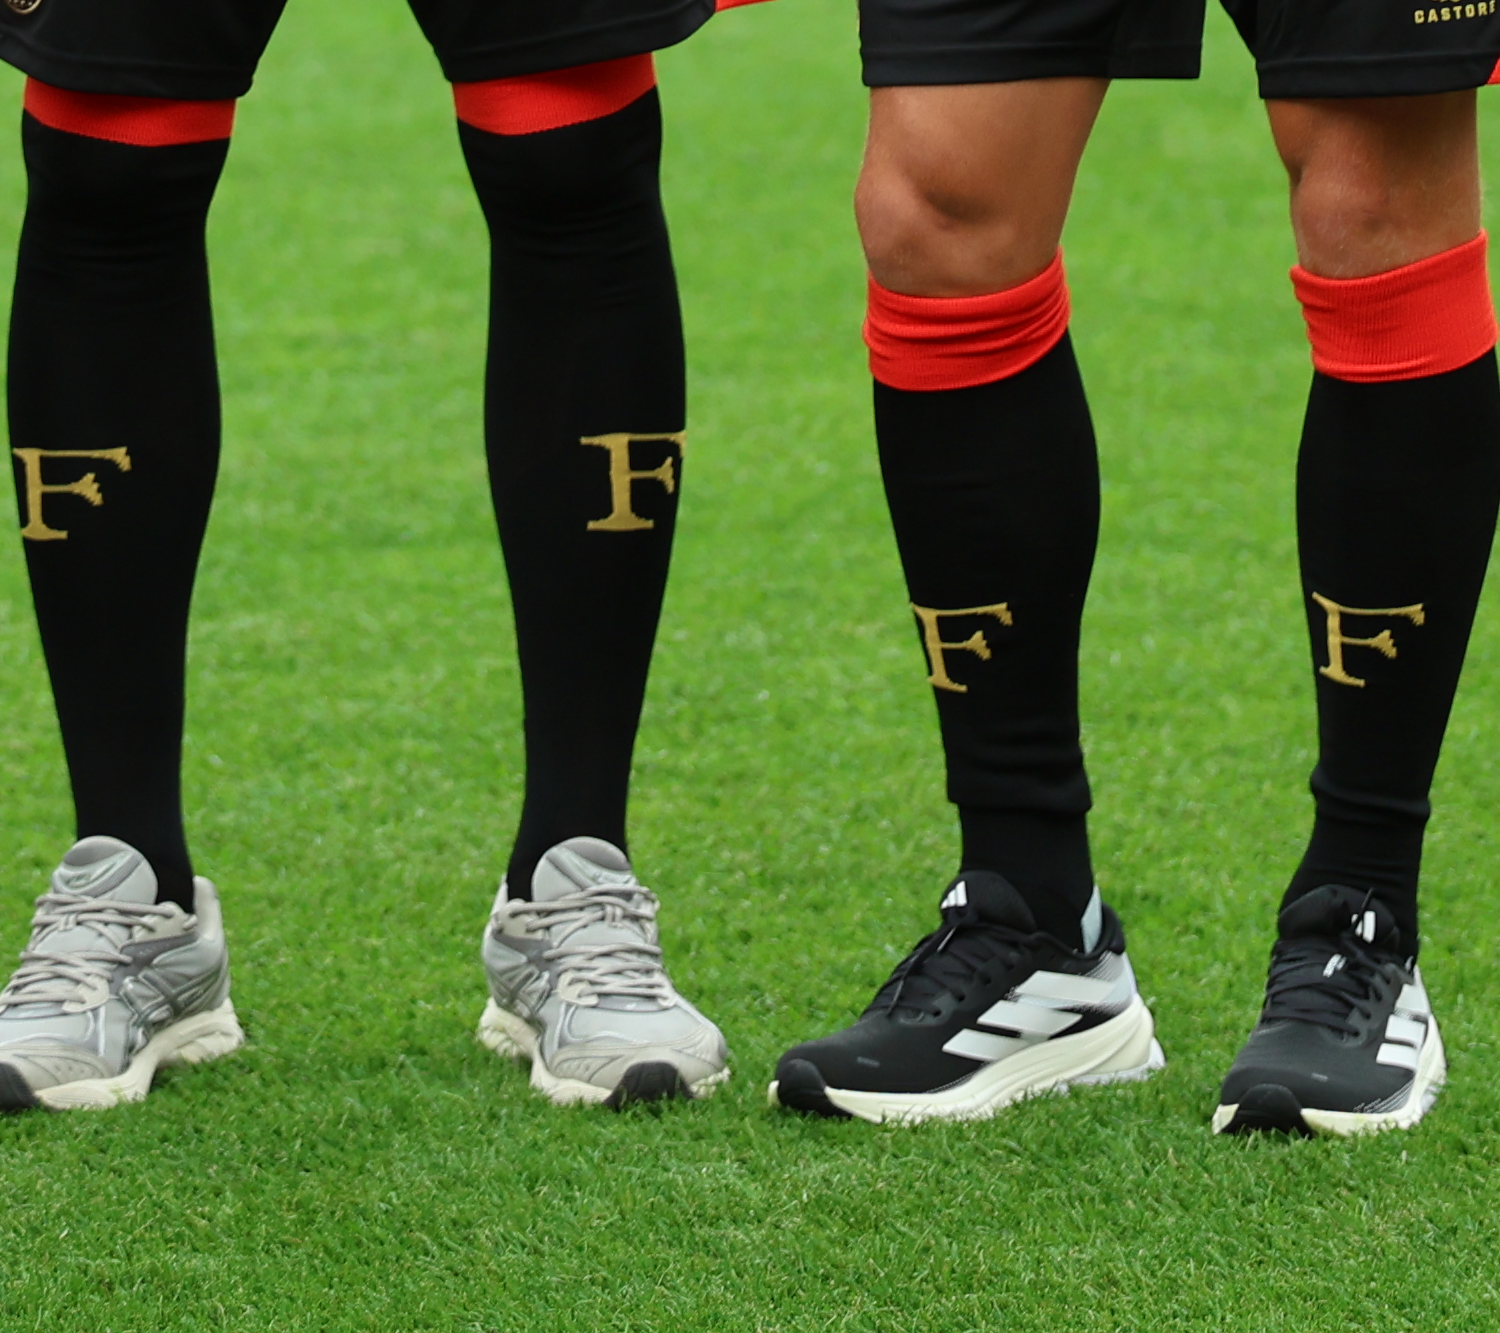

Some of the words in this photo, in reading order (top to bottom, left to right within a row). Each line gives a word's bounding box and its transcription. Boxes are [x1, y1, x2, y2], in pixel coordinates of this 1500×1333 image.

[1414, 0, 1496, 25] CASTORE
[12, 447, 131, 540] F
[579, 431, 685, 530] F
[910, 602, 1013, 692] F
[1312, 592, 1424, 687] F
